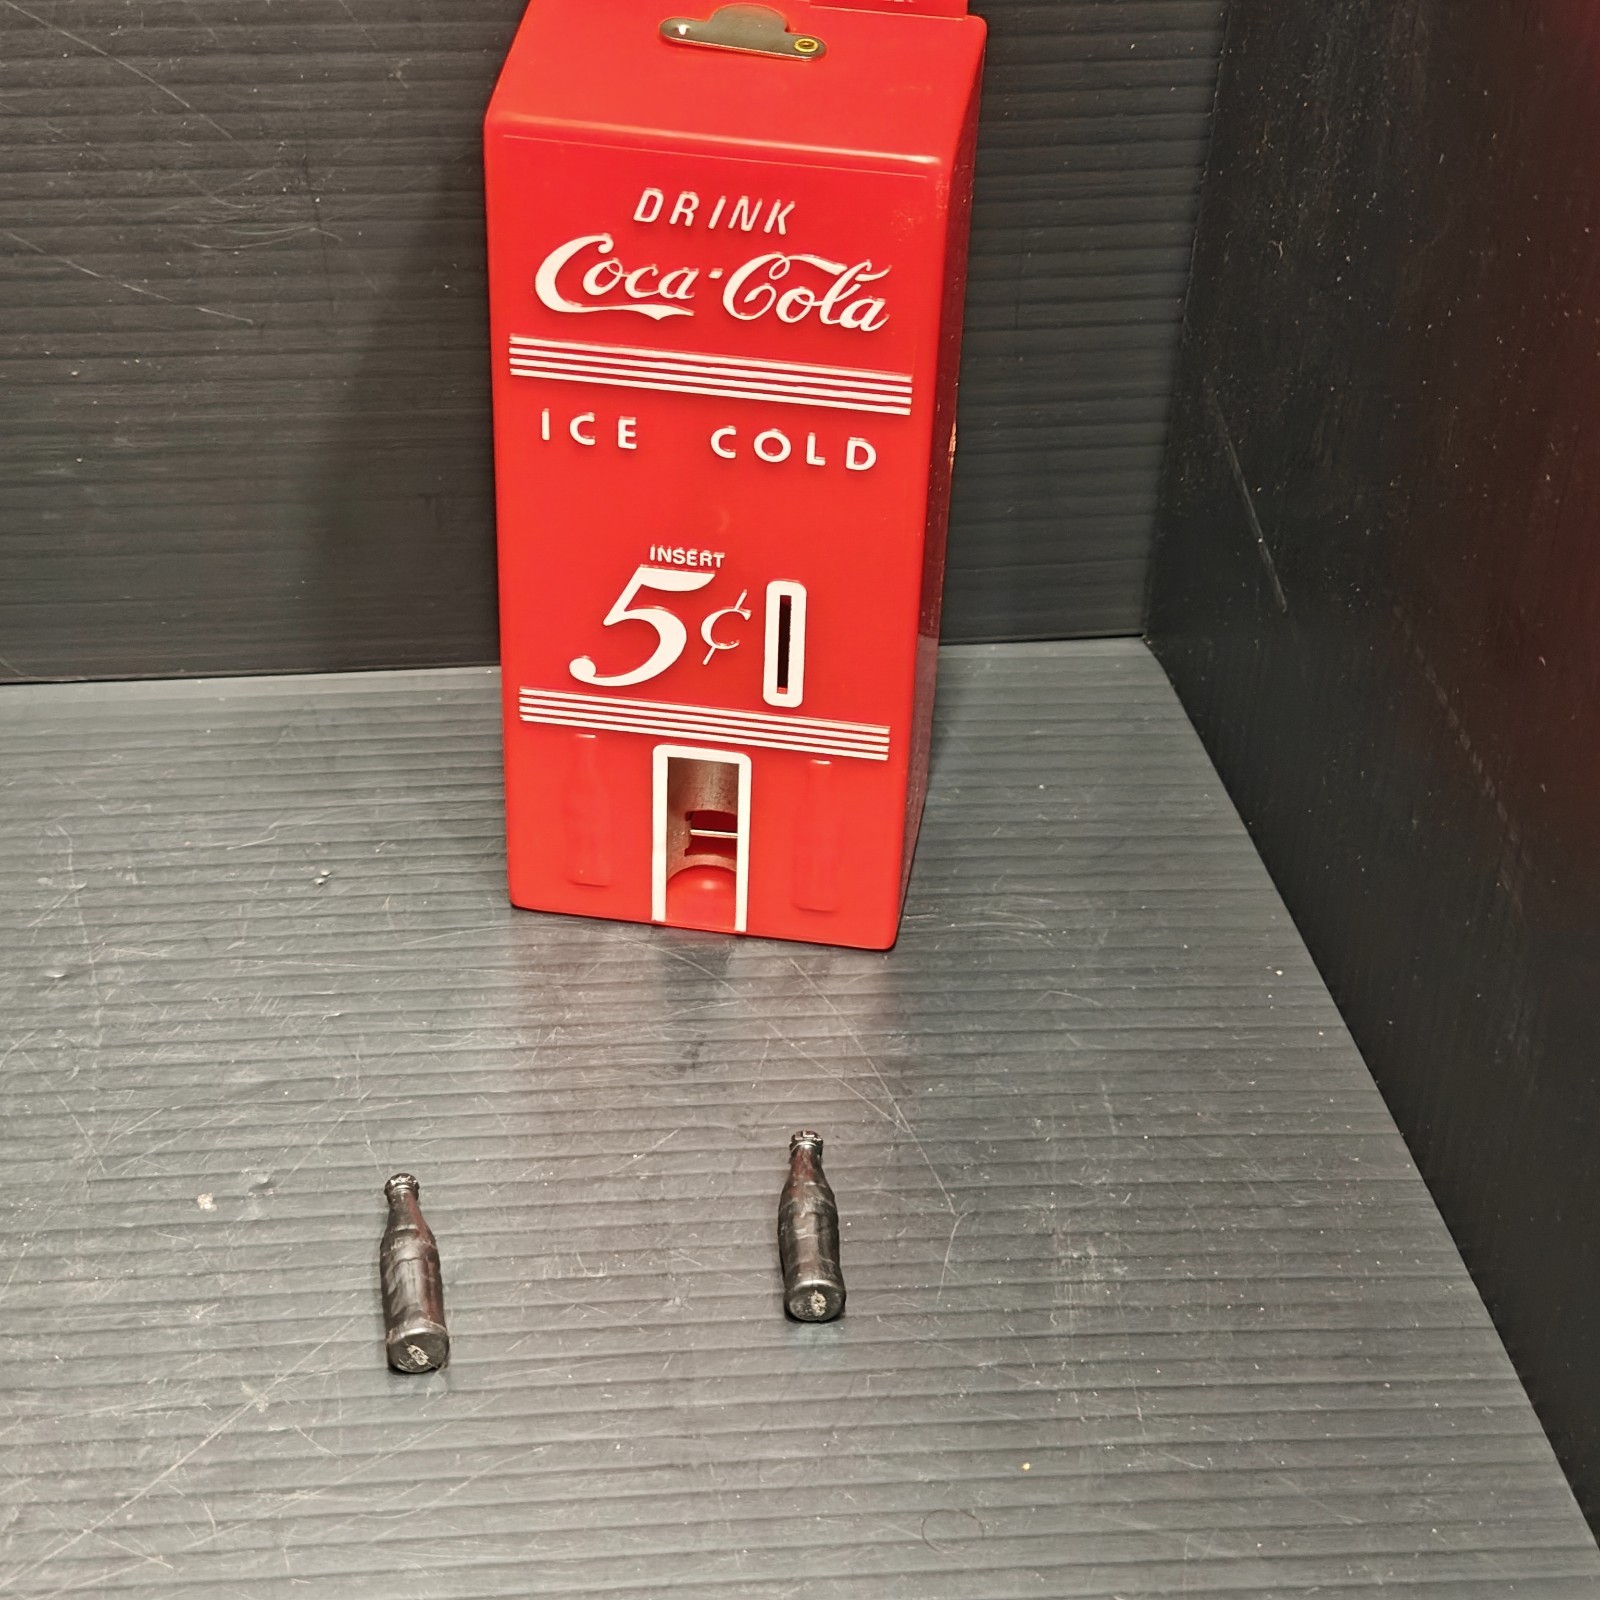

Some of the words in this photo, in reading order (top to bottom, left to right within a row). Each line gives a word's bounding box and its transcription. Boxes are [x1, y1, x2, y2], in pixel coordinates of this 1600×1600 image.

[632, 186, 796, 236] DRINK
[540, 408, 639, 451] ICE
[709, 424, 878, 473] COLD
[649, 544, 726, 569] INSERT
